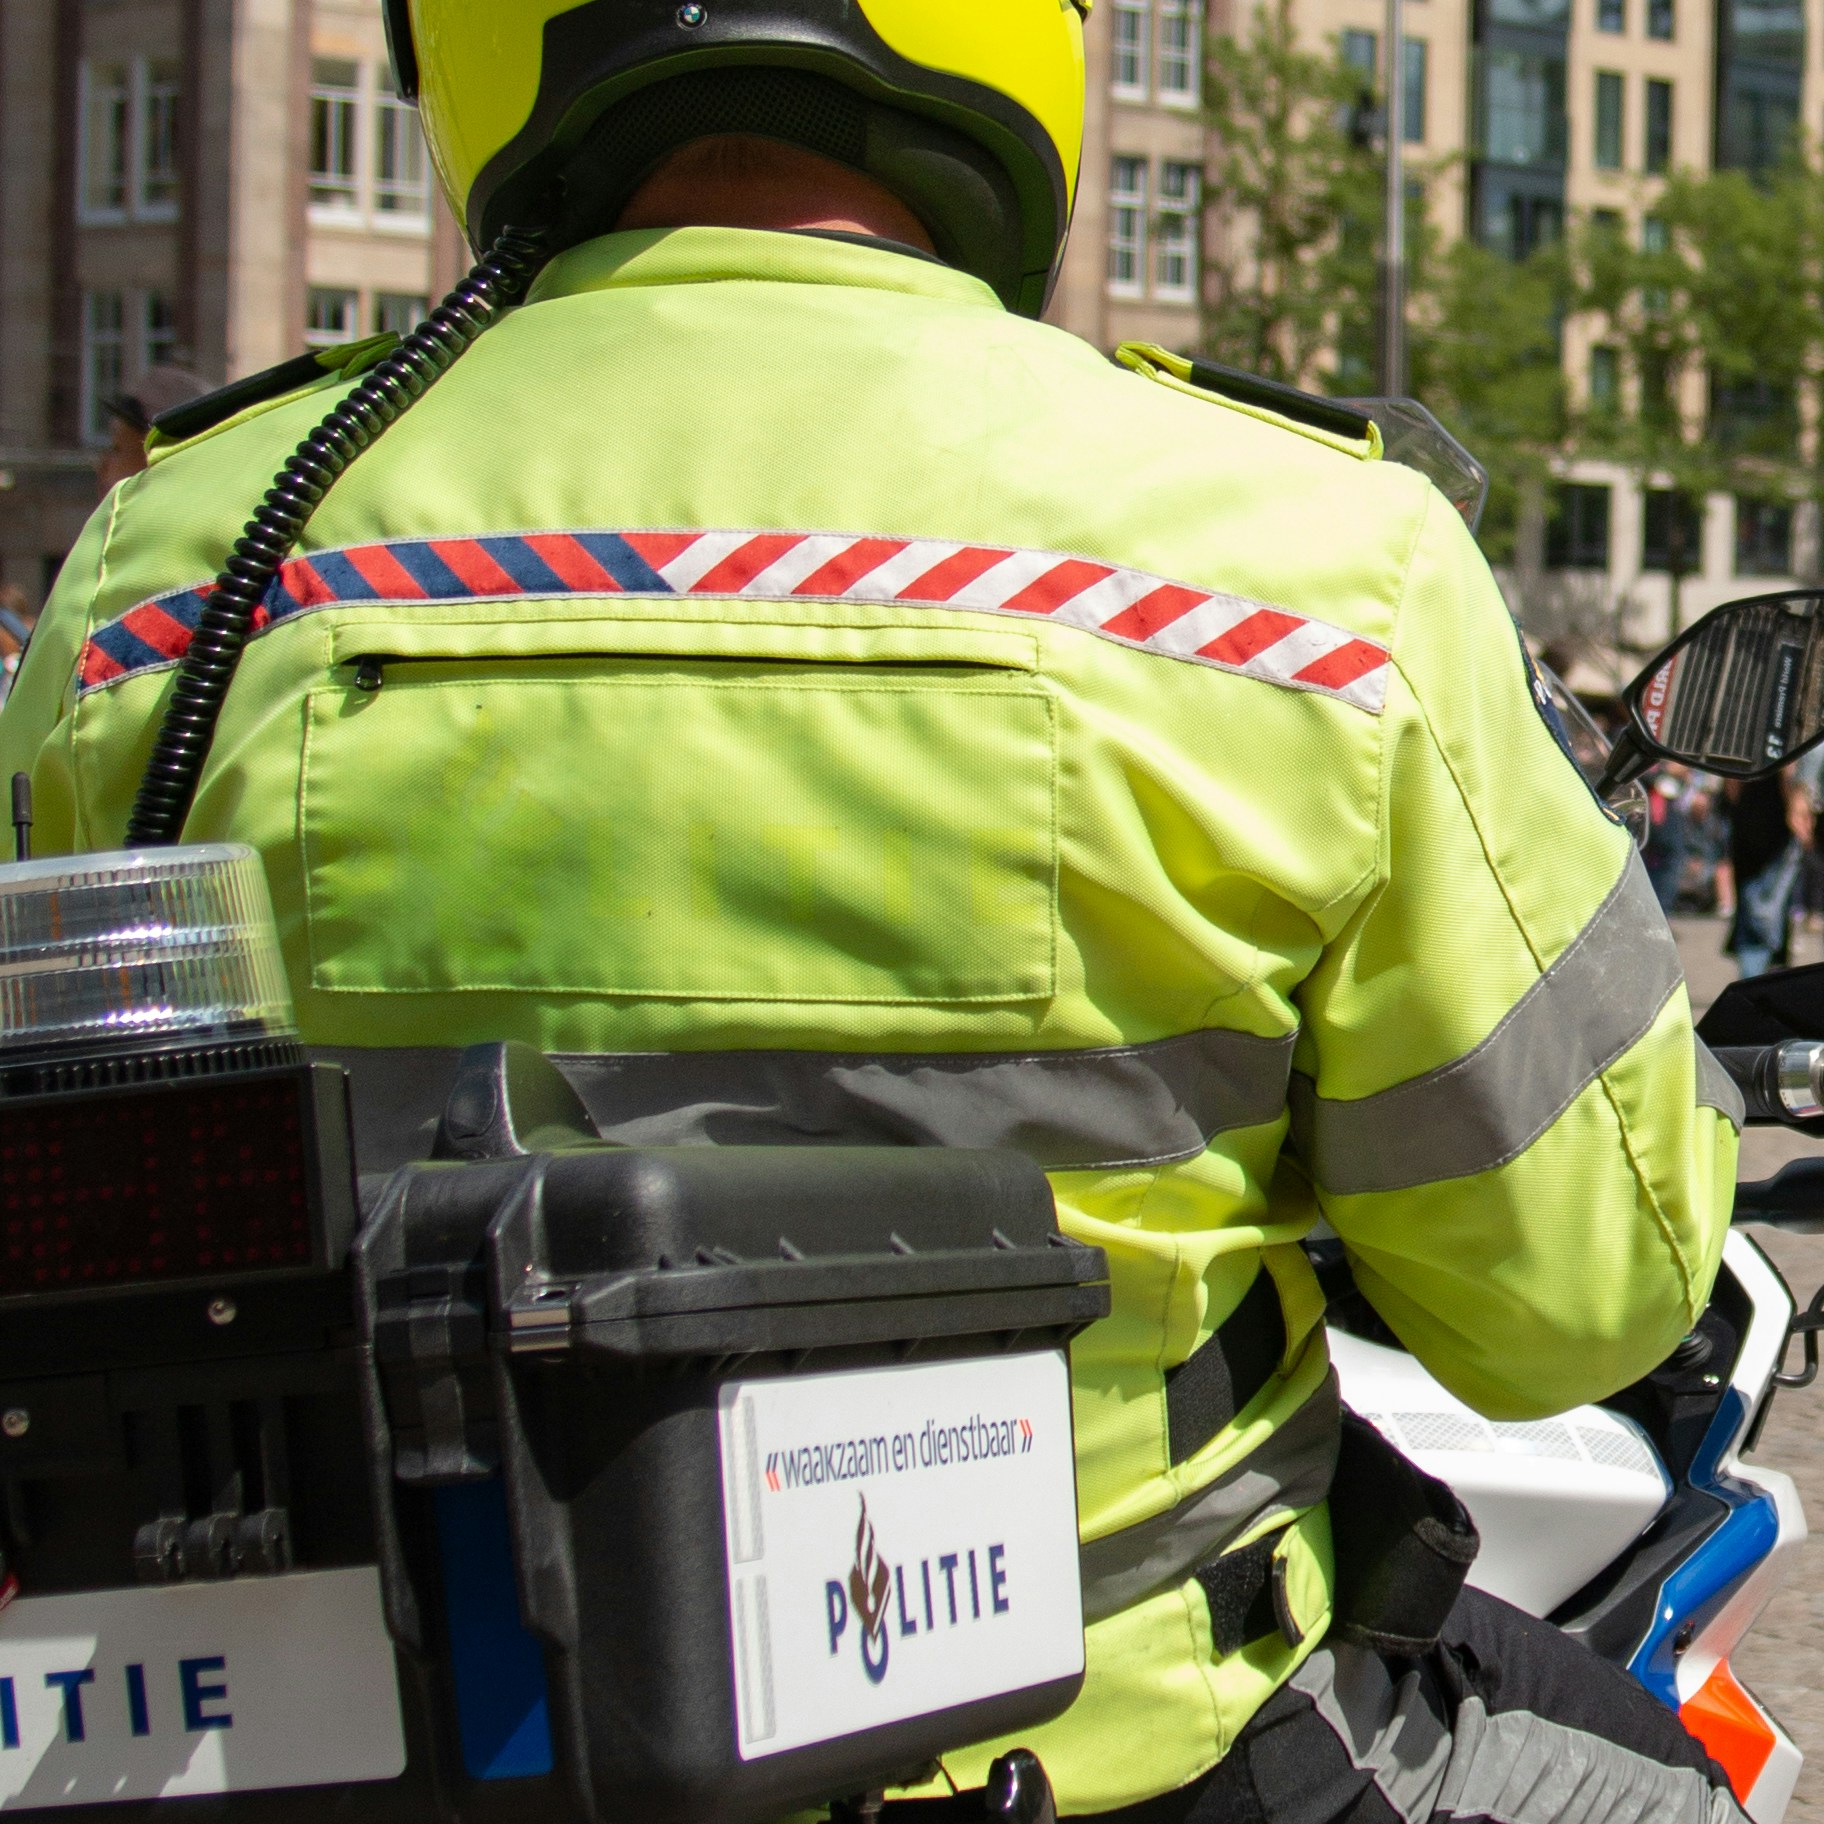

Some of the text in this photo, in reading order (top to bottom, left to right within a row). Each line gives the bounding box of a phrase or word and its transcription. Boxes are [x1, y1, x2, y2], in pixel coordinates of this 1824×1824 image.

[892, 1431, 917, 1473] en
[825, 1492, 1010, 1686] POLITIE
[0, 1656, 233, 1750] ITIE
